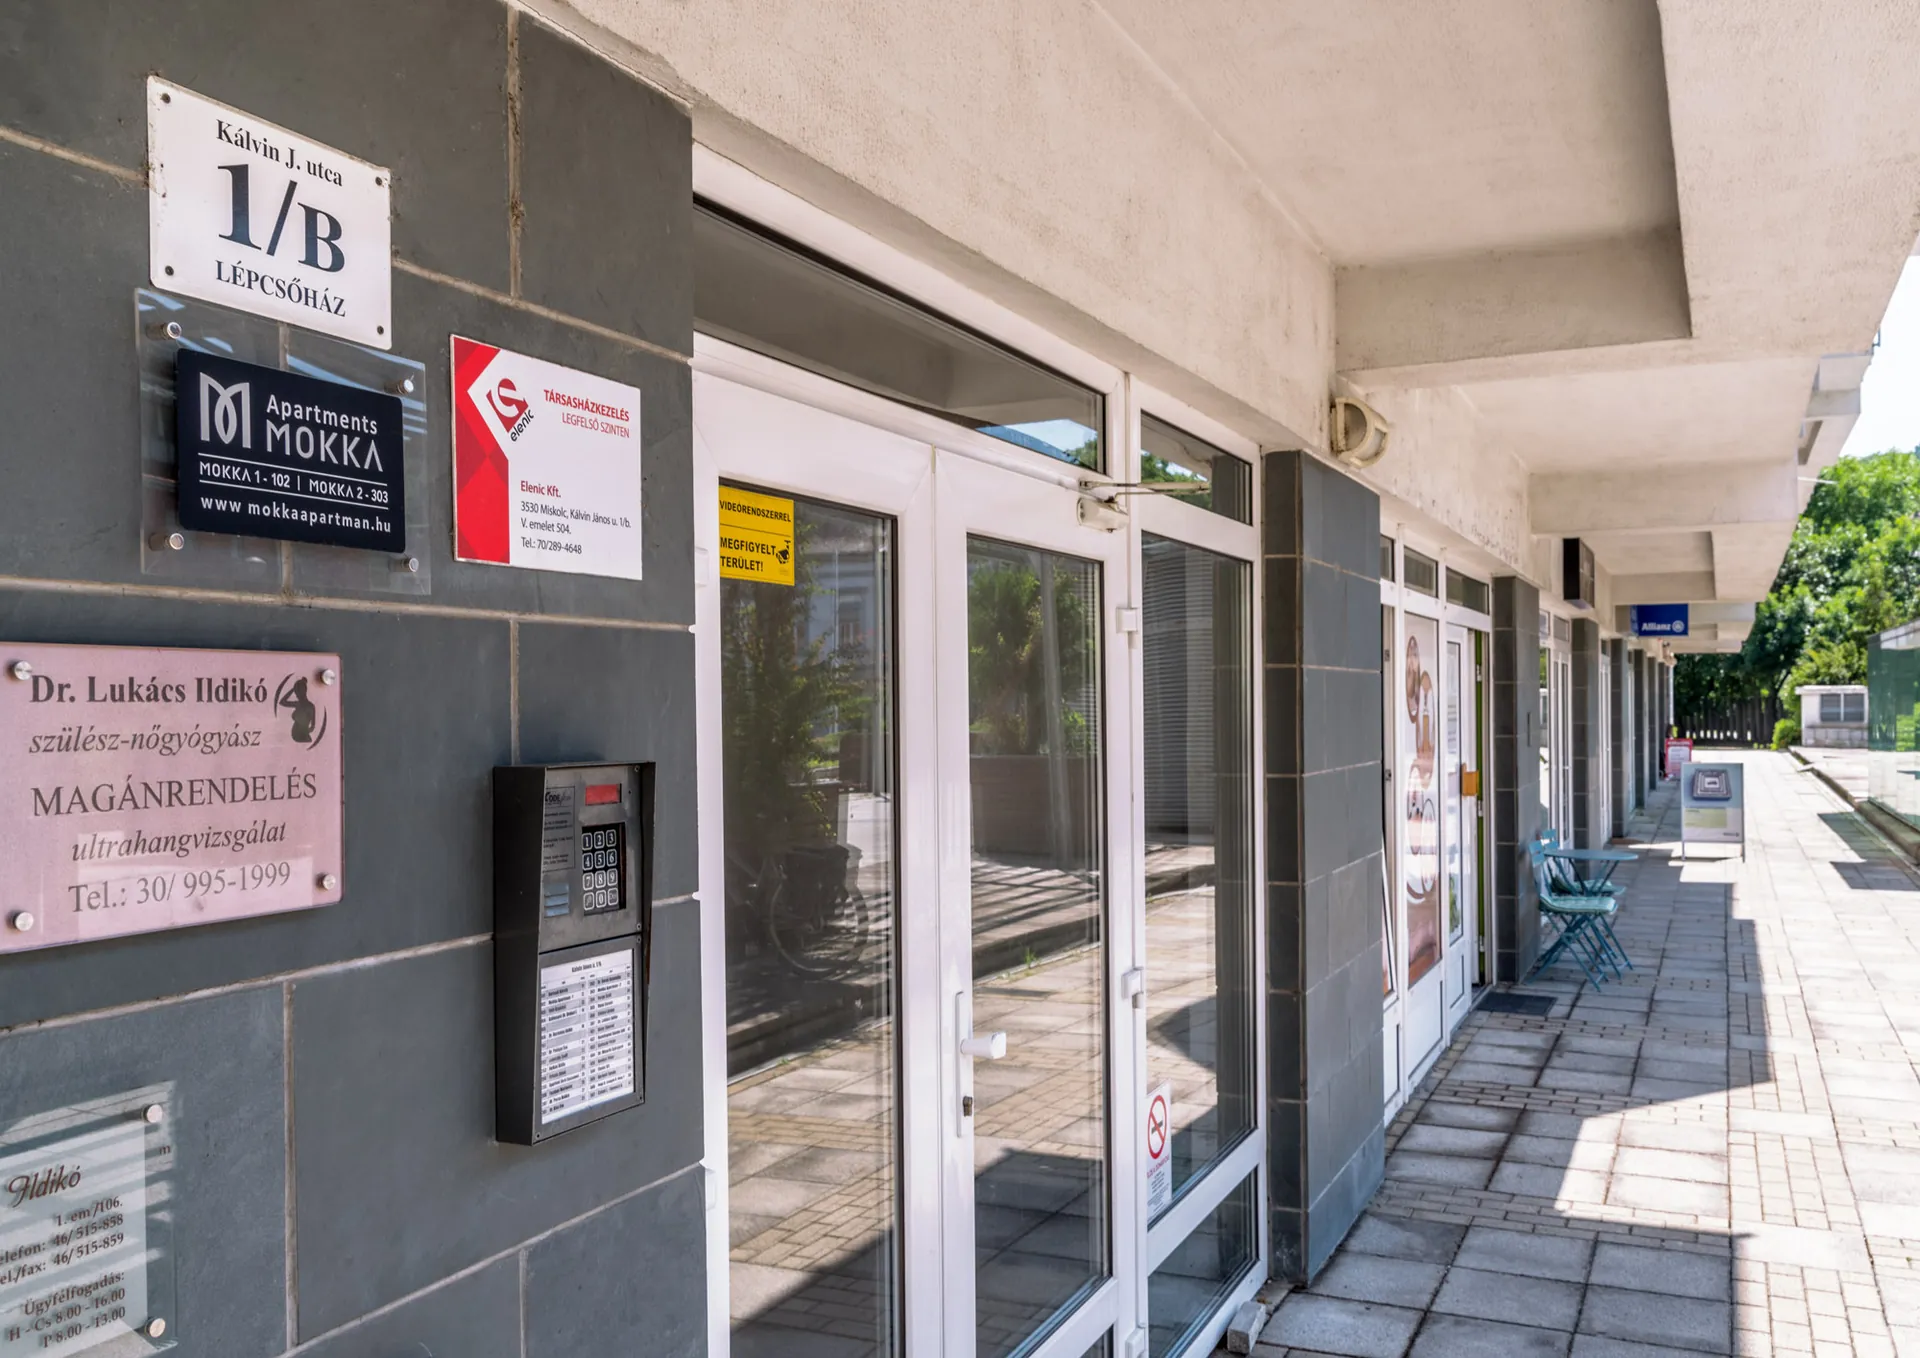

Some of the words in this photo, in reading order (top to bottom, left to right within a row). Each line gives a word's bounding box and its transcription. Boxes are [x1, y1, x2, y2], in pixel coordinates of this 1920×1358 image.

[216, 119, 280, 162] Kálvin
[285, 147, 301, 170] J.
[306, 159, 343, 187] utca
[217, 163, 346, 273] 1/B
[215, 260, 346, 317] LÉPCSŐHÁZ
[266, 394, 378, 435] Apartments
[544, 389, 630, 422] TÁRSASHÁZKEZELÉS
[510, 409, 535, 442] elenic
[600, 422, 630, 439] SZINTEN
[266, 418, 384, 473] MOKKA
[200, 460, 251, 482] MOKKA
[309, 478, 354, 498] MOKKA
[520, 480, 546, 496] Elenic
[546, 485, 562, 498] Kft.
[520, 500, 540, 514] 3530
[540, 504, 569, 520] Miskolc,
[570, 508, 591, 522] Kálvin
[592, 512, 611, 526] János
[520, 517, 528, 529] V.
[529, 520, 555, 532] emelet
[556, 523, 572, 535] 504.
[720, 500, 792, 522] VIDEÓRENDSZERREL
[520, 536, 536, 549] Tel.:
[537, 539, 582, 554] 70/289-4648
[720, 537, 776, 556] MEGFIGYELT
[720, 555, 764, 572] TERÜLET!
[1642, 622, 1671, 632] Allianz
[30, 674, 76, 704] Dr.
[88, 675, 186, 704] Lukács
[195, 676, 268, 704] Ildikó
[29, 724, 262, 756] szülész-nőgyógyász
[32, 767, 318, 816] MAGÁNRENDELÉS
[72, 819, 287, 862] ultrahangvizsgálat
[68, 880, 128, 913] Tel.:
[183, 861, 290, 898] 995-1999
